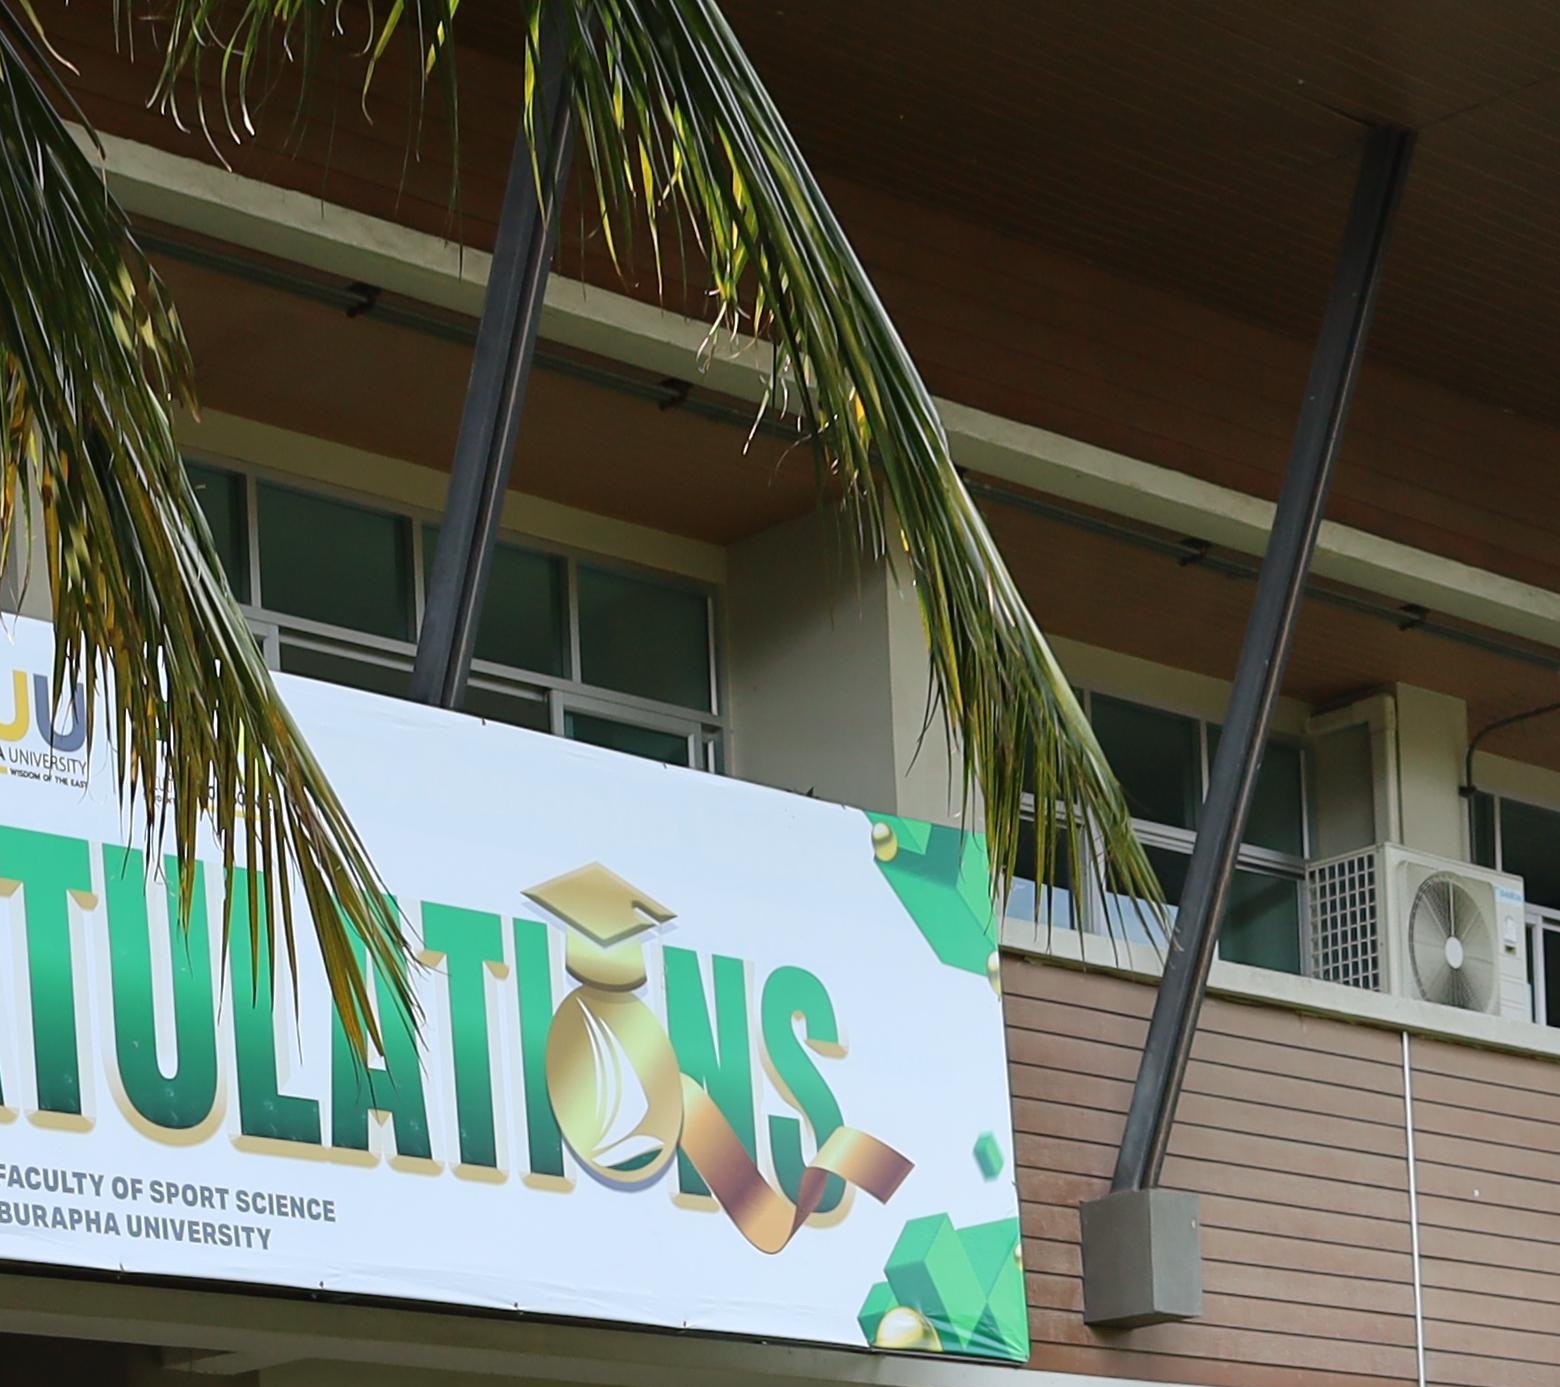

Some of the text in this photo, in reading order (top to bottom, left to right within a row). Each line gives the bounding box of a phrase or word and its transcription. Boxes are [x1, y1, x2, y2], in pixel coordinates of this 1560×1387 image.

[7, 746, 87, 776] UNIVERSITY
[9, 767, 41, 782] WISDOM
[42, 774, 52, 784] OF
[54, 776, 69, 788] THE
[111, 1170, 144, 1201] OF
[149, 1180, 229, 1210] SPORT
[235, 1189, 337, 1223] SCIENCE
[126, 1214, 271, 1251] UNIVERSITY
